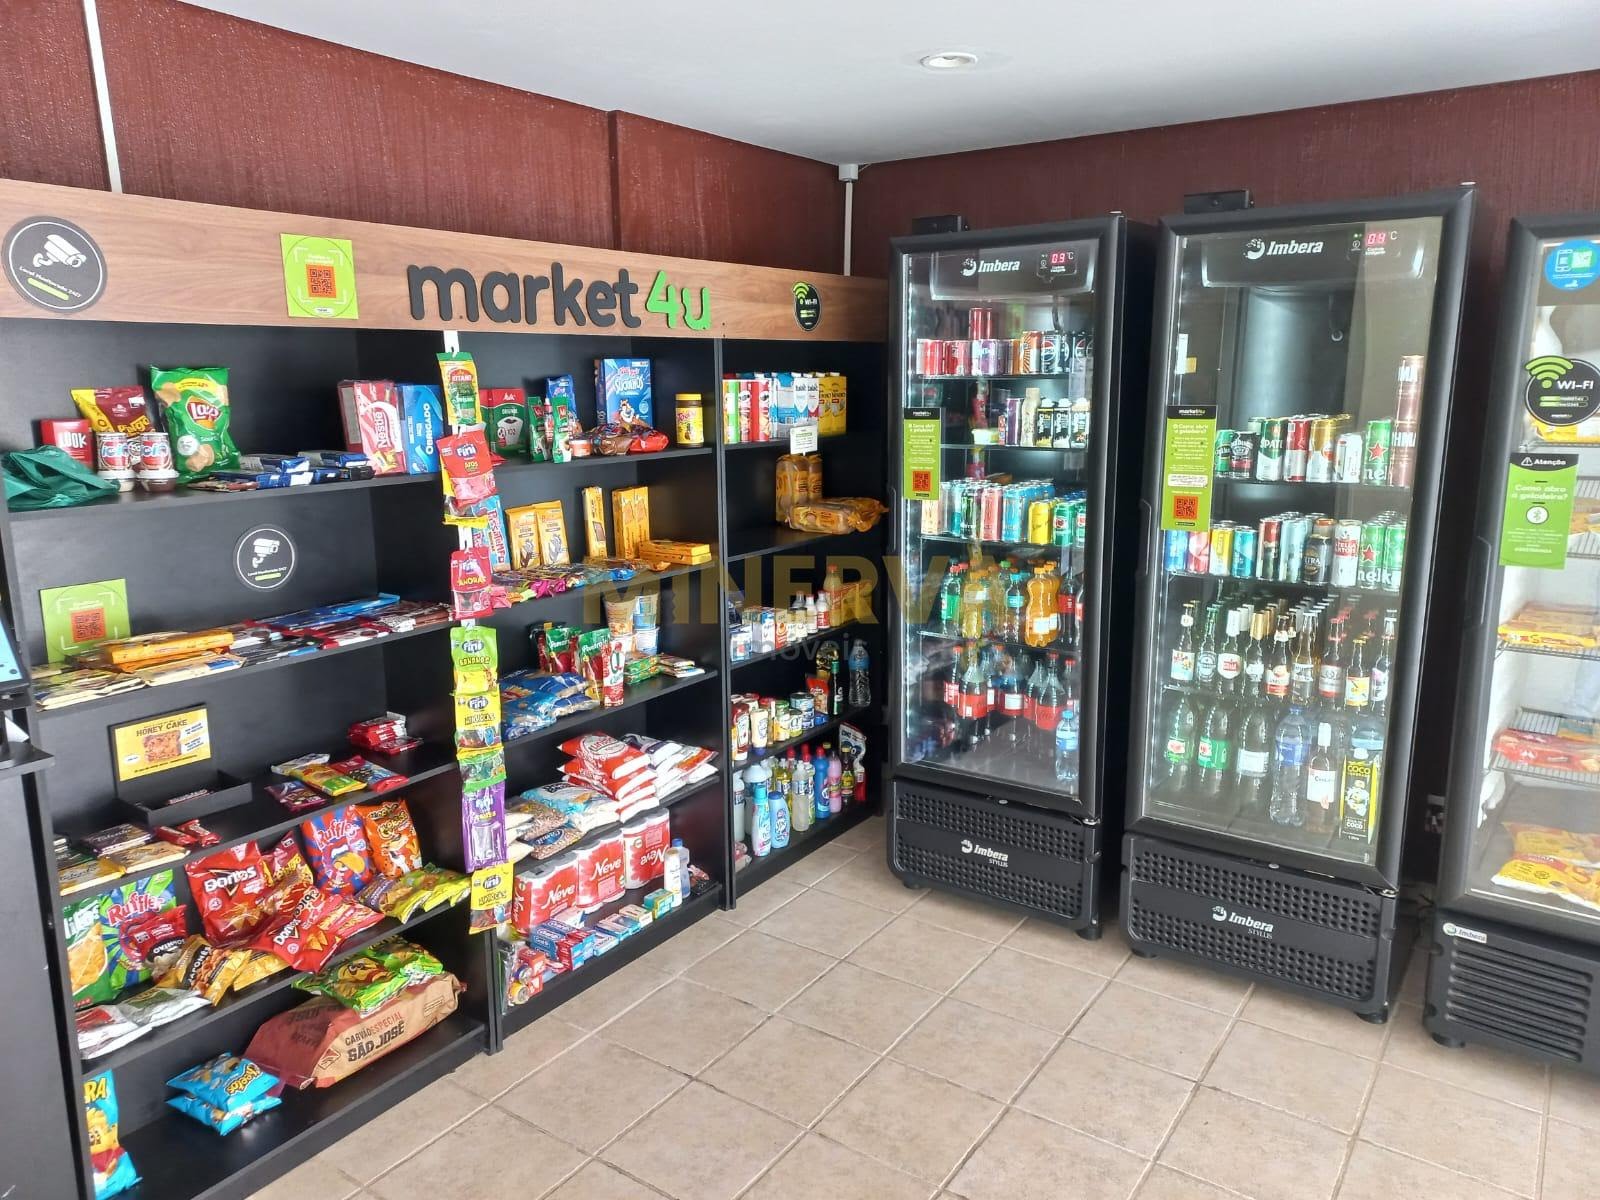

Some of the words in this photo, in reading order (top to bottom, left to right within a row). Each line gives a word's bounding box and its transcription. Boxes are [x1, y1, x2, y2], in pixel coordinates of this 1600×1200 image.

[1267, 239, 1324, 256] Imbera
[978, 259, 1021, 273] Imbera
[1557, 380, 1594, 390] WI-FI
[422, 402, 434, 455] OBRIGADO
[456, 443, 477, 458] Fini
[1534, 457, 1567, 467] Atenção
[1515, 483, 1542, 494] Como
[1543, 484, 1566, 494] abro
[1519, 491, 1568, 502] geladeira?
[463, 640, 484, 653] Fini
[468, 697, 488, 710] Fini
[136, 725, 163, 738] HONEY
[164, 719, 188, 731] CAKE
[1347, 765, 1371, 775] COCO
[316, 819, 360, 847] Ruffles
[1346, 821, 1363, 830] COCO
[974, 845, 1009, 862] Imbera
[589, 857, 622, 881] Neve
[203, 866, 258, 893] Doritos
[482, 875, 501, 890] Fini
[541, 883, 575, 909] Neve
[107, 891, 165, 926] Ruffles
[1228, 911, 1274, 932] Imbera
[273, 917, 302, 946] Doritos
[344, 1027, 372, 1047] CARVÃO
[370, 1011, 403, 1036] ESPECIAL
[347, 1040, 375, 1062] SÃO
[374, 1021, 405, 1050] JOSÉ
[226, 1064, 261, 1094] Cheetos
